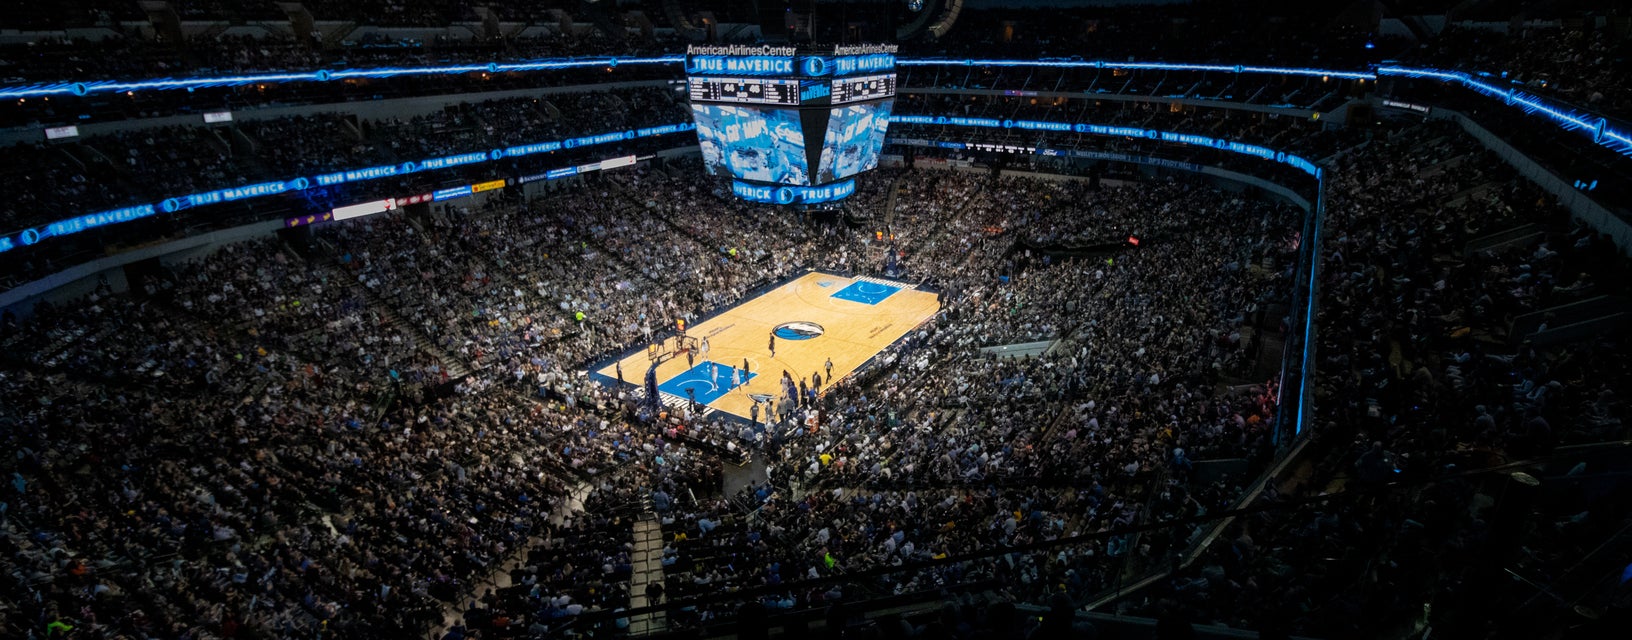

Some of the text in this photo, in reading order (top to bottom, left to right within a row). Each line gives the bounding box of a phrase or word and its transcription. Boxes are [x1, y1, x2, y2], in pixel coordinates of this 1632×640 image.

[687, 44, 796, 56] AmericanAirlinesCenter
[834, 43, 899, 56] AmericanAirlinesCenter
[693, 58, 792, 72] TRUE MAVERICK
[836, 56, 894, 71] TRUE MAVERICK
[901, 116, 934, 124] MAVERICK
[951, 117, 1000, 127] TRUE MAVERICK
[1018, 120, 1071, 131] TRUE MAVERICK
[1090, 124, 1144, 137] TRUE MAVERICK
[578, 132, 624, 146] TRUE MAVERICK
[1161, 131, 1214, 146] TRUE MAVERICK
[506, 141, 561, 156] TRUE MAVERICK
[421, 152, 487, 170] TRUE MAVERICK
[317, 165, 396, 185] TRUE MAVERICK
[188, 181, 285, 206] TRUE MAVERICK
[801, 189, 830, 200] TRUE
[85, 204, 155, 226] MAVERICK
